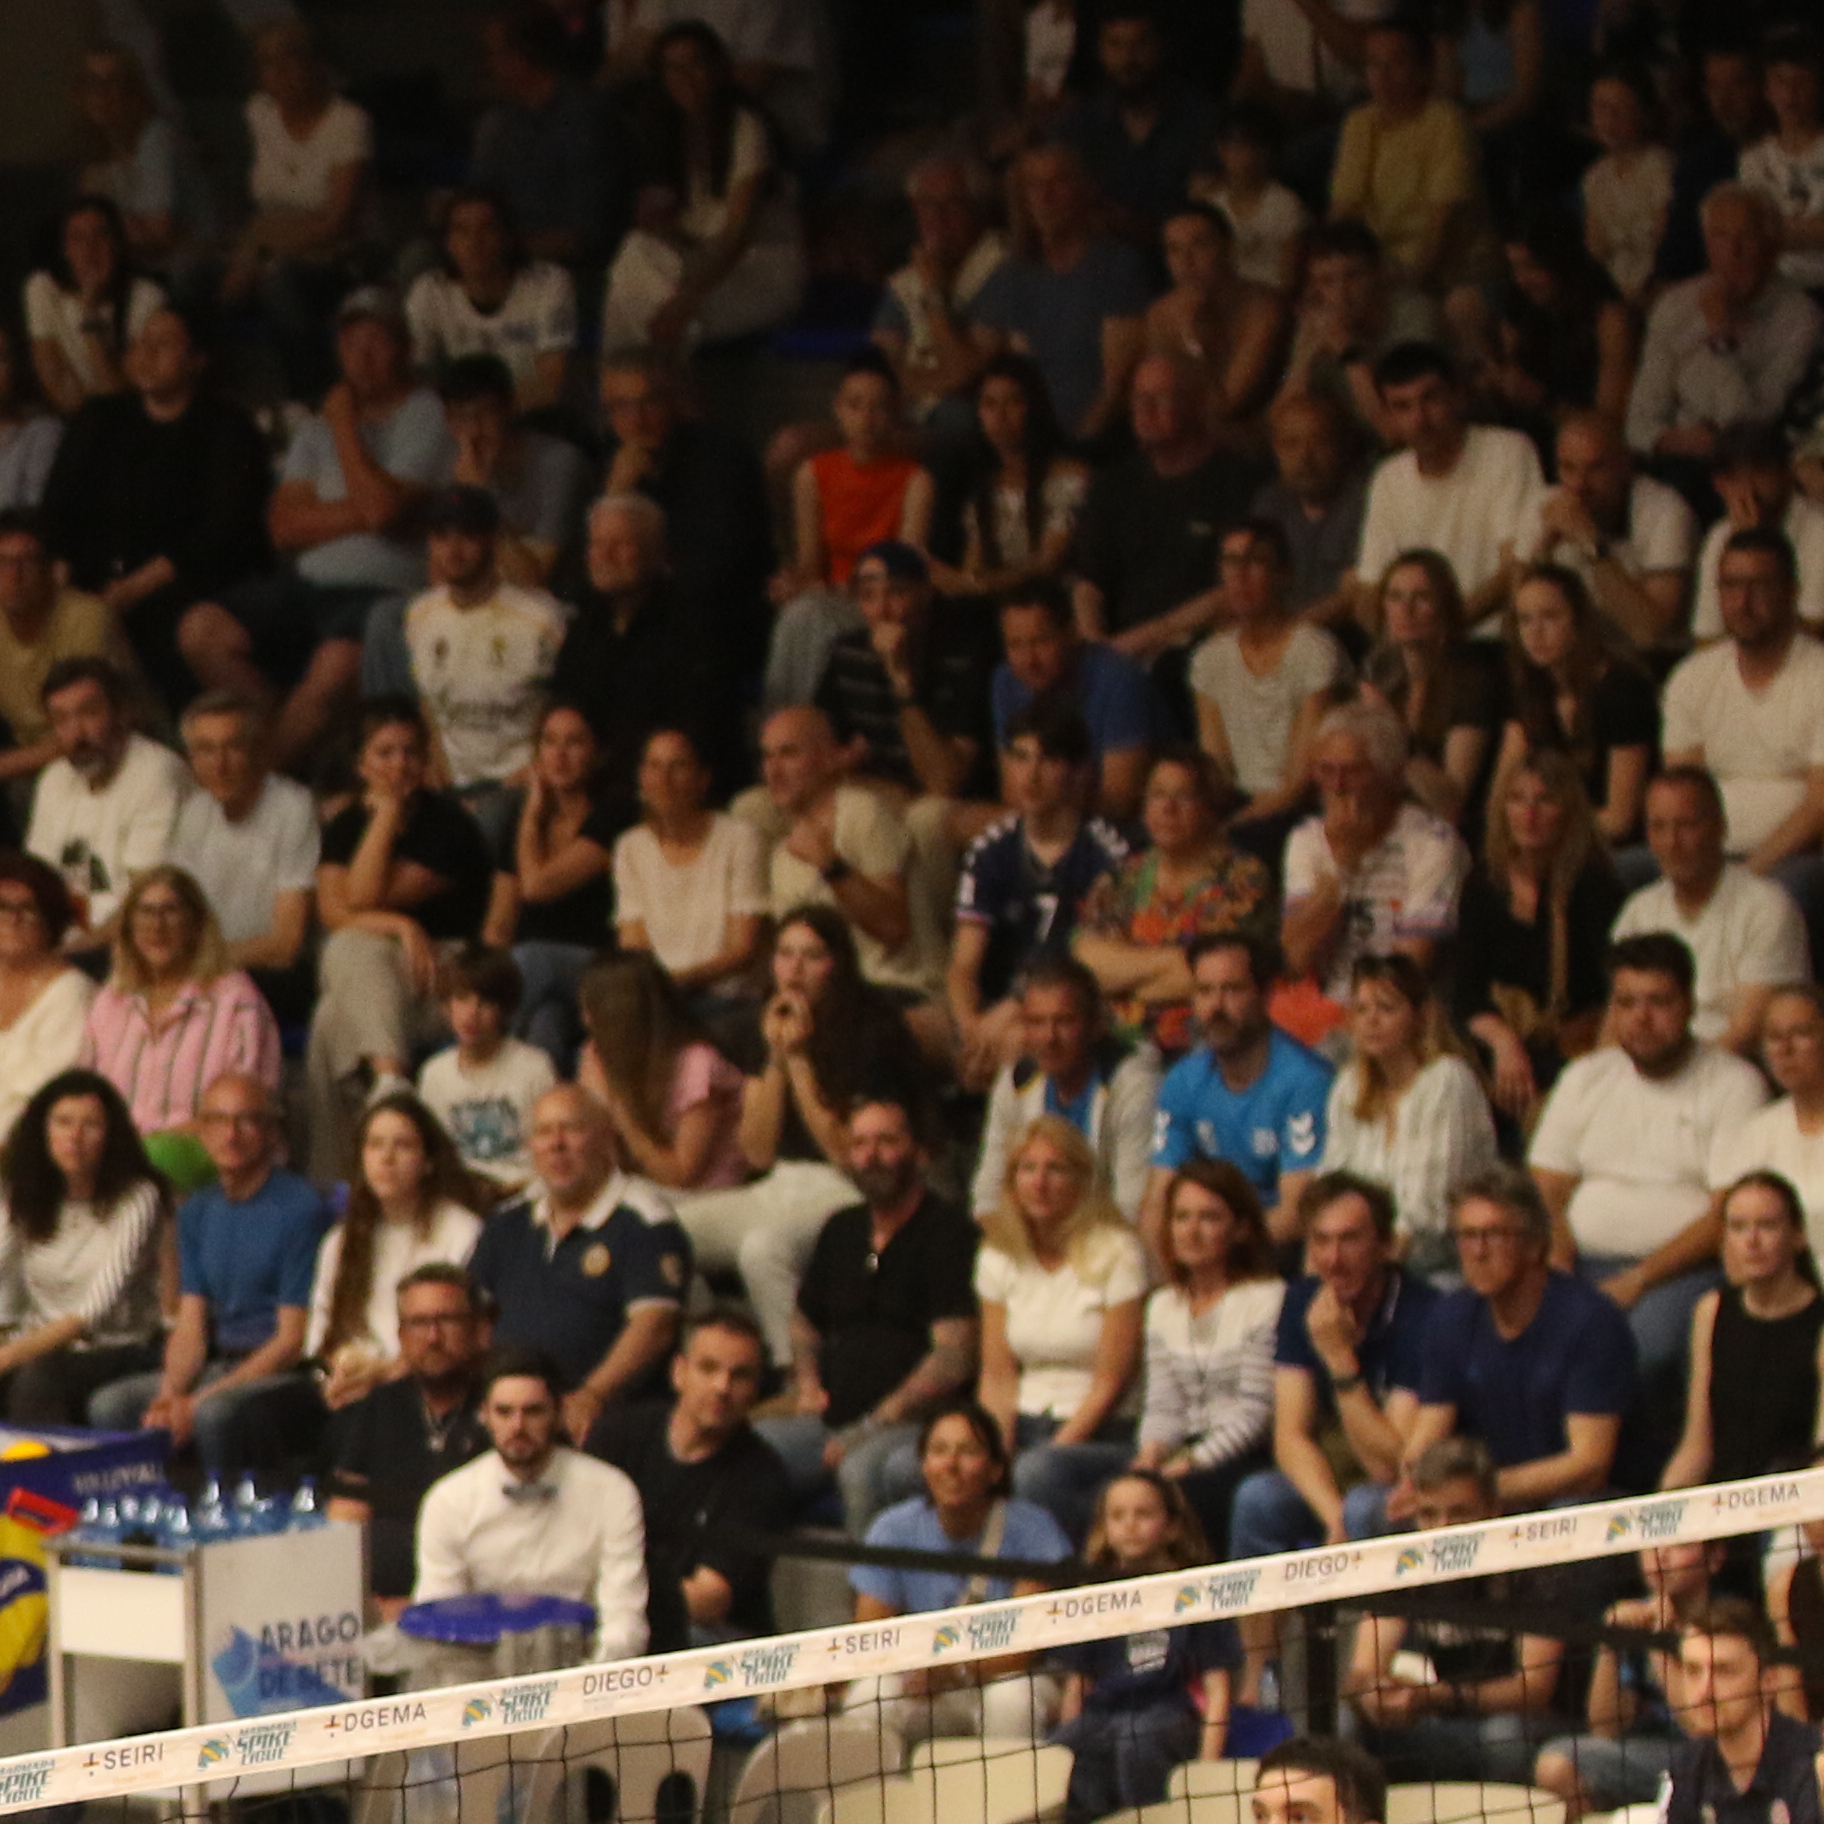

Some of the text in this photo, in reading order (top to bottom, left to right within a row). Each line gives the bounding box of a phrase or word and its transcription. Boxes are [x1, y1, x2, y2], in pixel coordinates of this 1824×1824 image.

[1284, 1551, 1348, 1582] DIEGO
[1065, 1589, 1143, 1618] DGEMA
[260, 1611, 360, 1652] ARAGO
[845, 1627, 902, 1654] SEIRI
[582, 1664, 652, 1697] DIEGO
[343, 1701, 428, 1733] DGEMA
[104, 1741, 164, 1771] SEIRI
